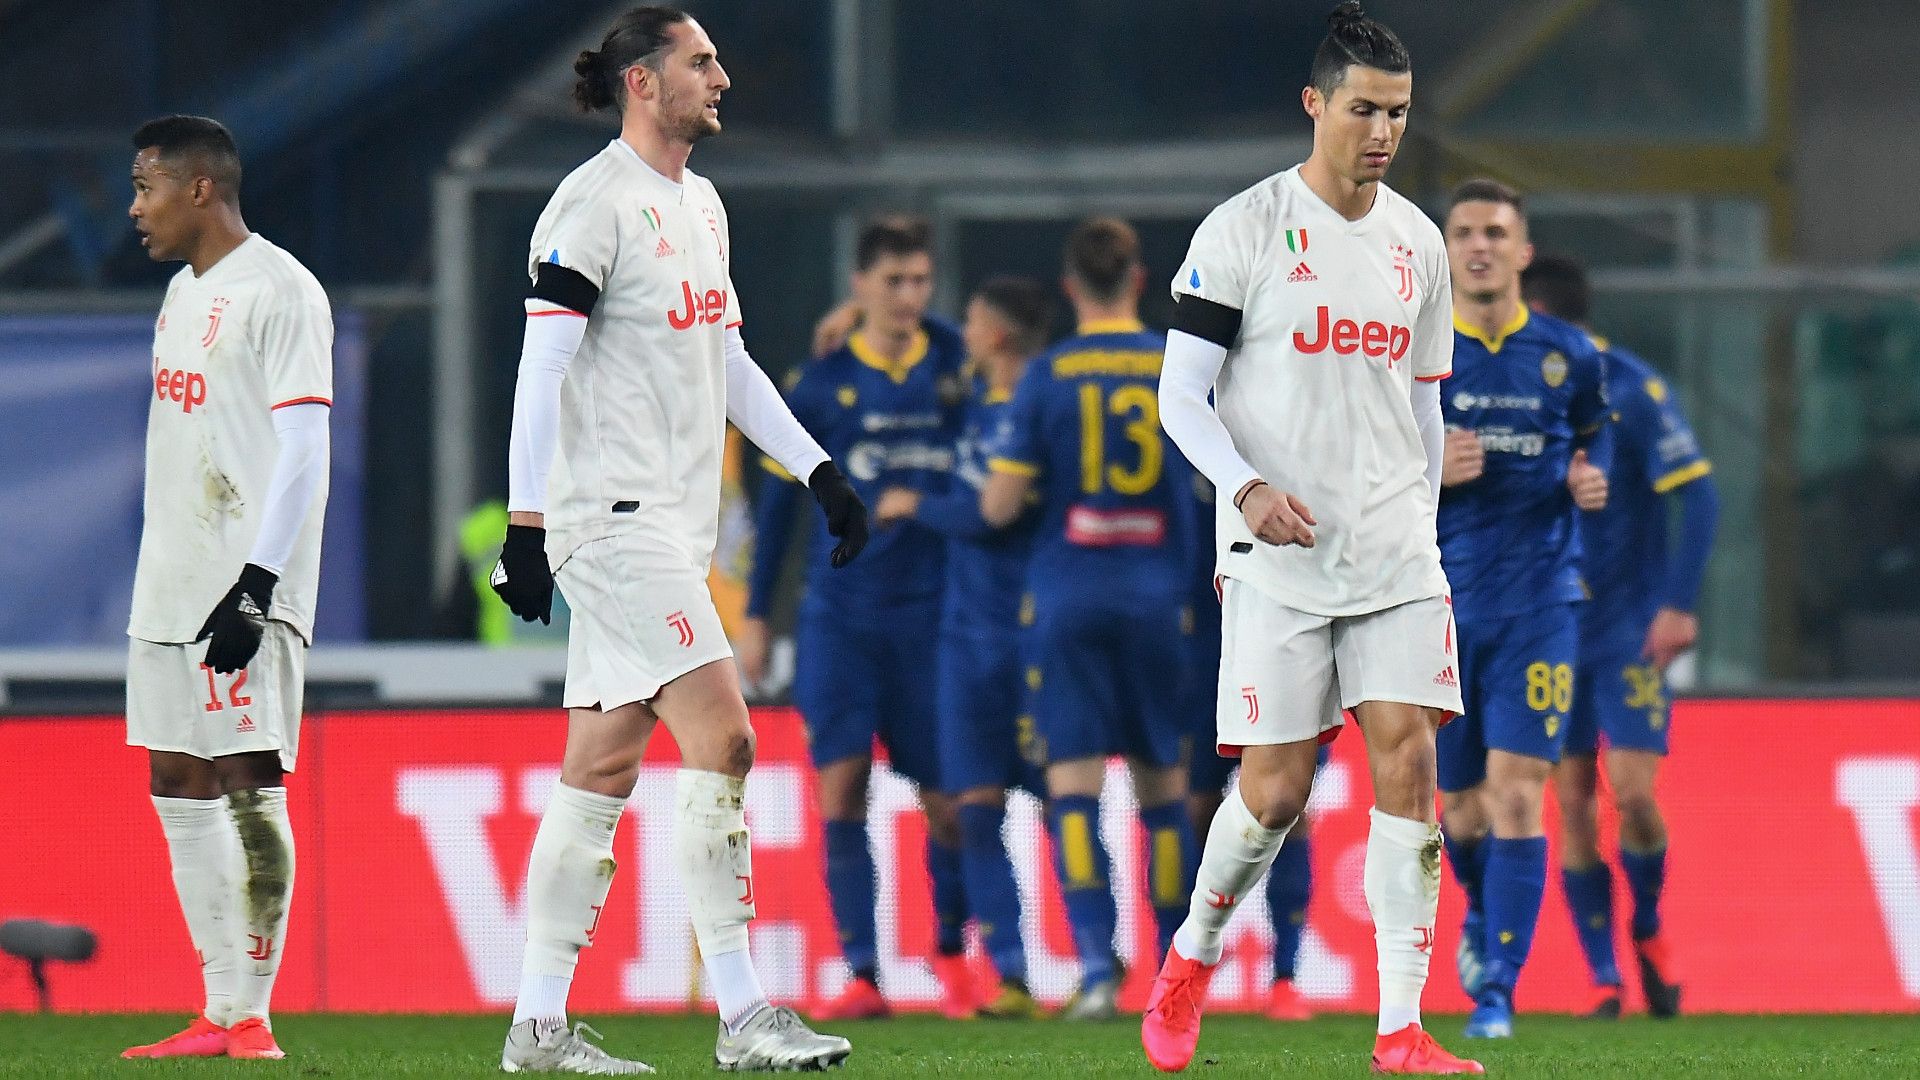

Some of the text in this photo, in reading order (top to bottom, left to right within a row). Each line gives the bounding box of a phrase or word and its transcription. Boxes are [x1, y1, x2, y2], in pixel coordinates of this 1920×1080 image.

[1292, 305, 1411, 369] Jeep
[155, 356, 207, 414] eep
[1077, 384, 1163, 494] 13
[199, 661, 252, 712] 12
[1526, 662, 1573, 713] 88
